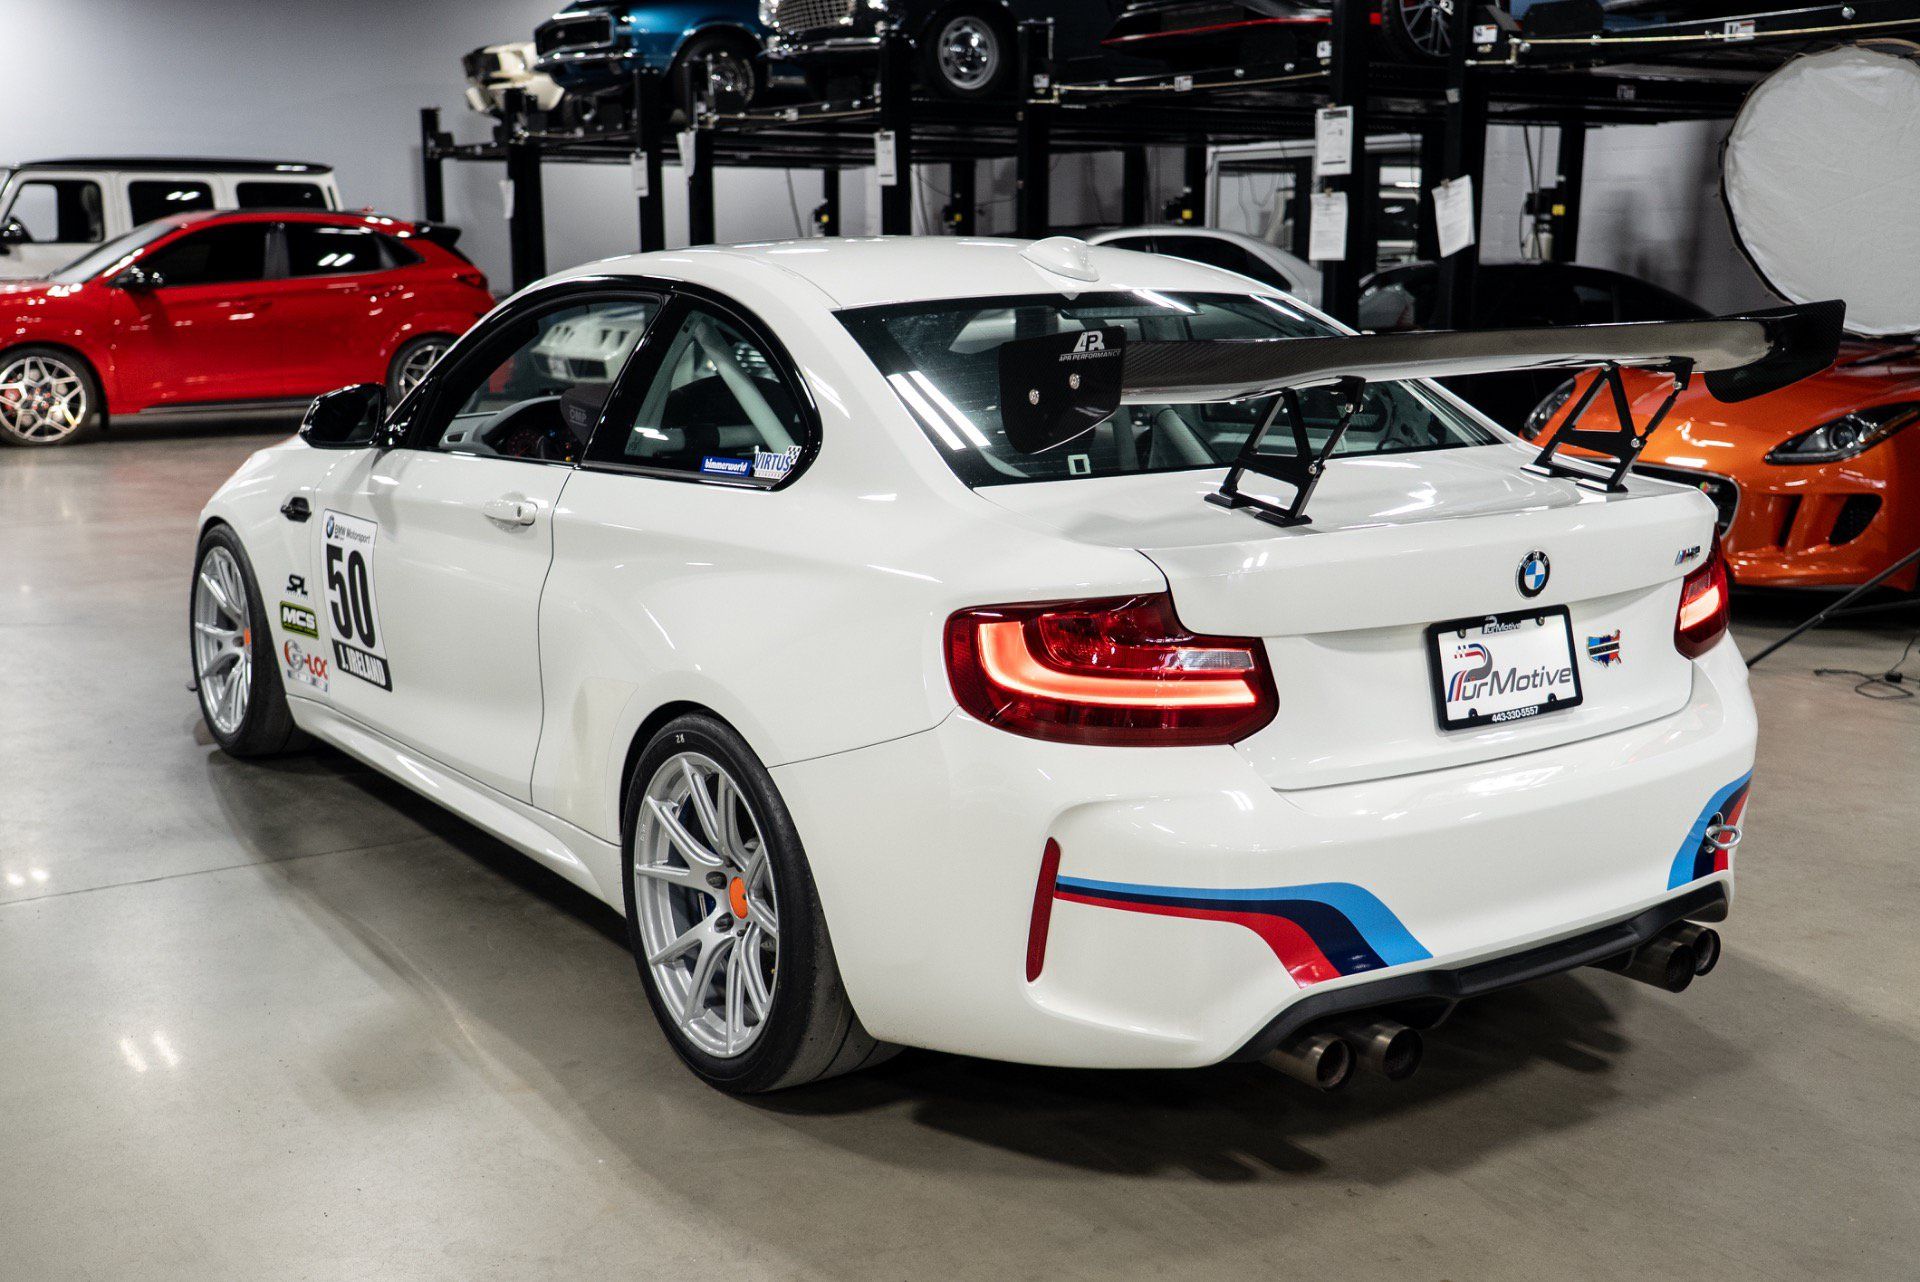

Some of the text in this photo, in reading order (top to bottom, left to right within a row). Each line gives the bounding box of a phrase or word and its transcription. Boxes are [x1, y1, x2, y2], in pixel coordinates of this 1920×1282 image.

[1072, 349, 1121, 360] PERFORMANCE
[704, 458, 748, 472] bimmerworld
[755, 452, 791, 471] VIRTUS
[326, 543, 376, 648] 50
[283, 606, 315, 630] MCS
[1491, 705, 1539, 723] 443-330-5557
